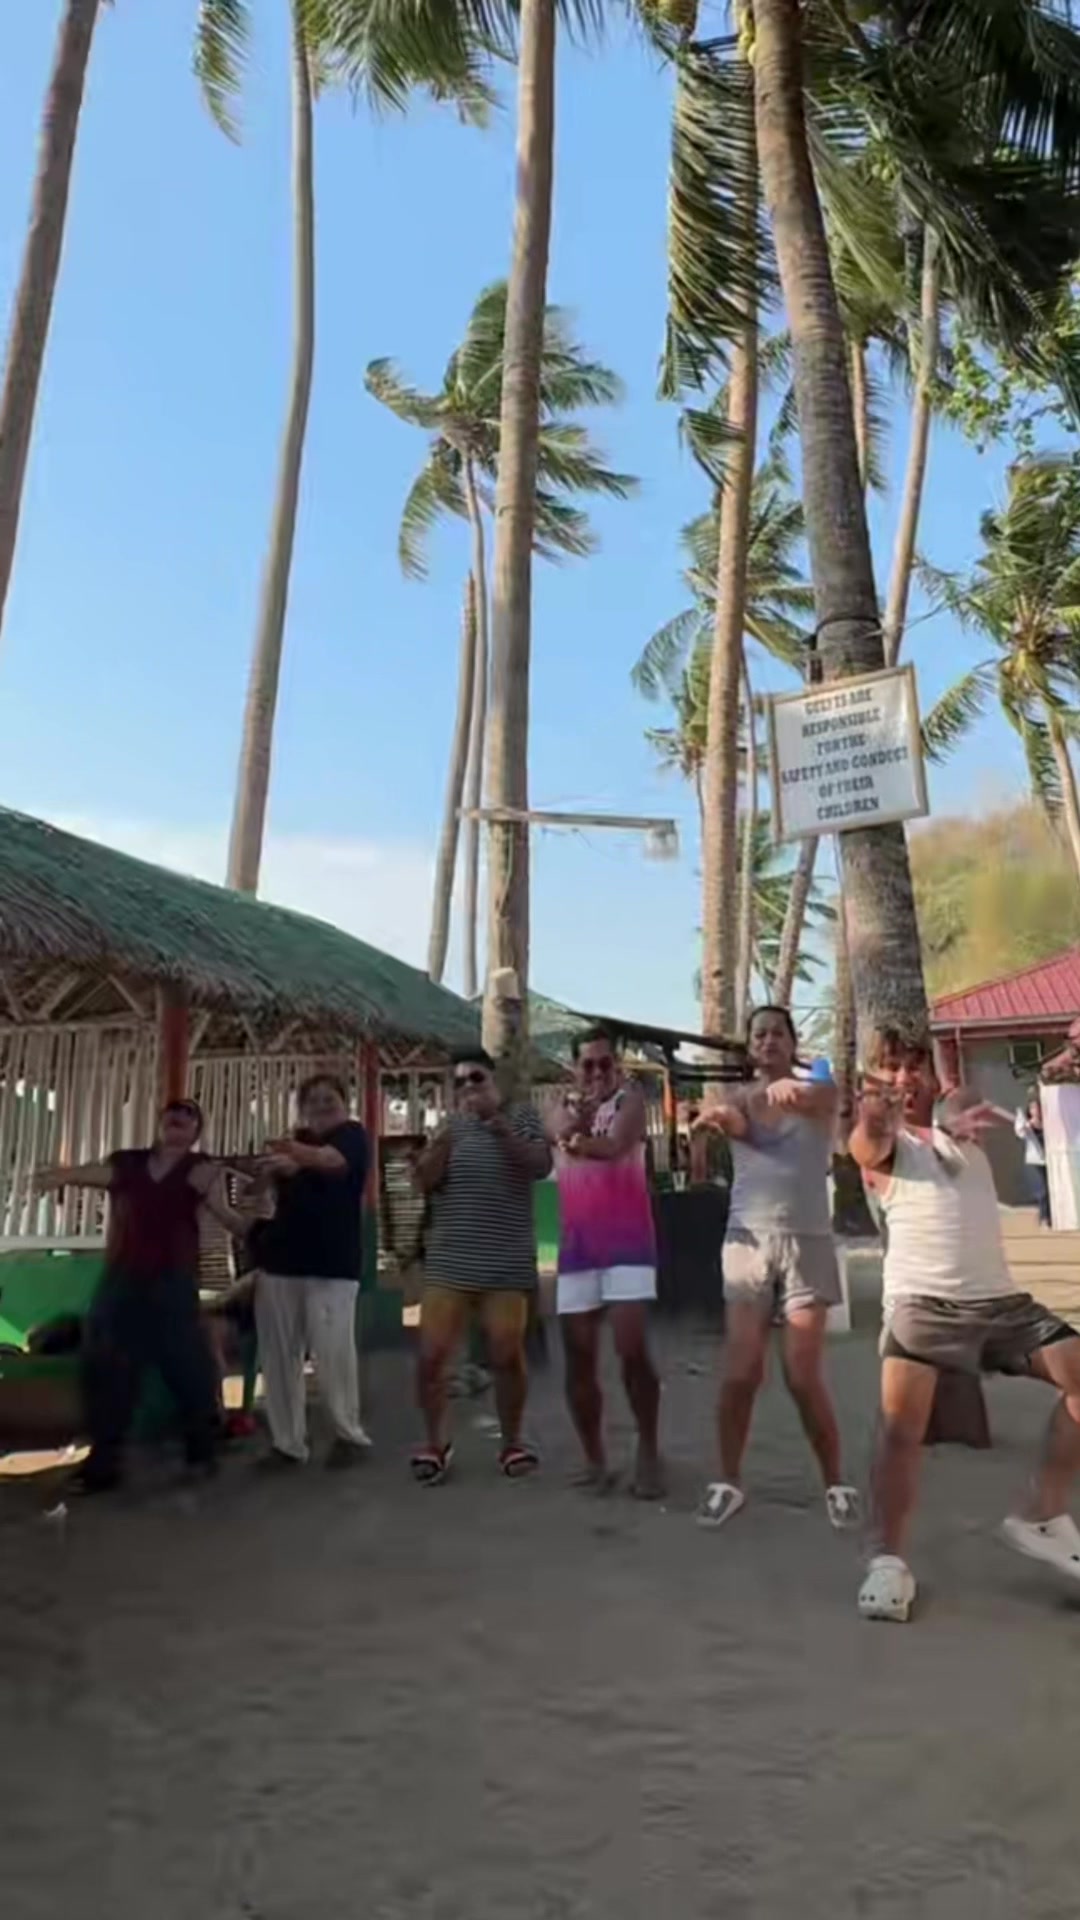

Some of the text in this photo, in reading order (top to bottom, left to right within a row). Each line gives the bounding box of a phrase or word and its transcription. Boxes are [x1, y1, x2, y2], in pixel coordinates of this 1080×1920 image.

[802, 707, 881, 738] RESPONSIBLE
[824, 758, 849, 775] AND
[851, 746, 908, 769] CONDUCT
[818, 781, 833, 798] OF
[817, 796, 879, 820] CHILDREN
